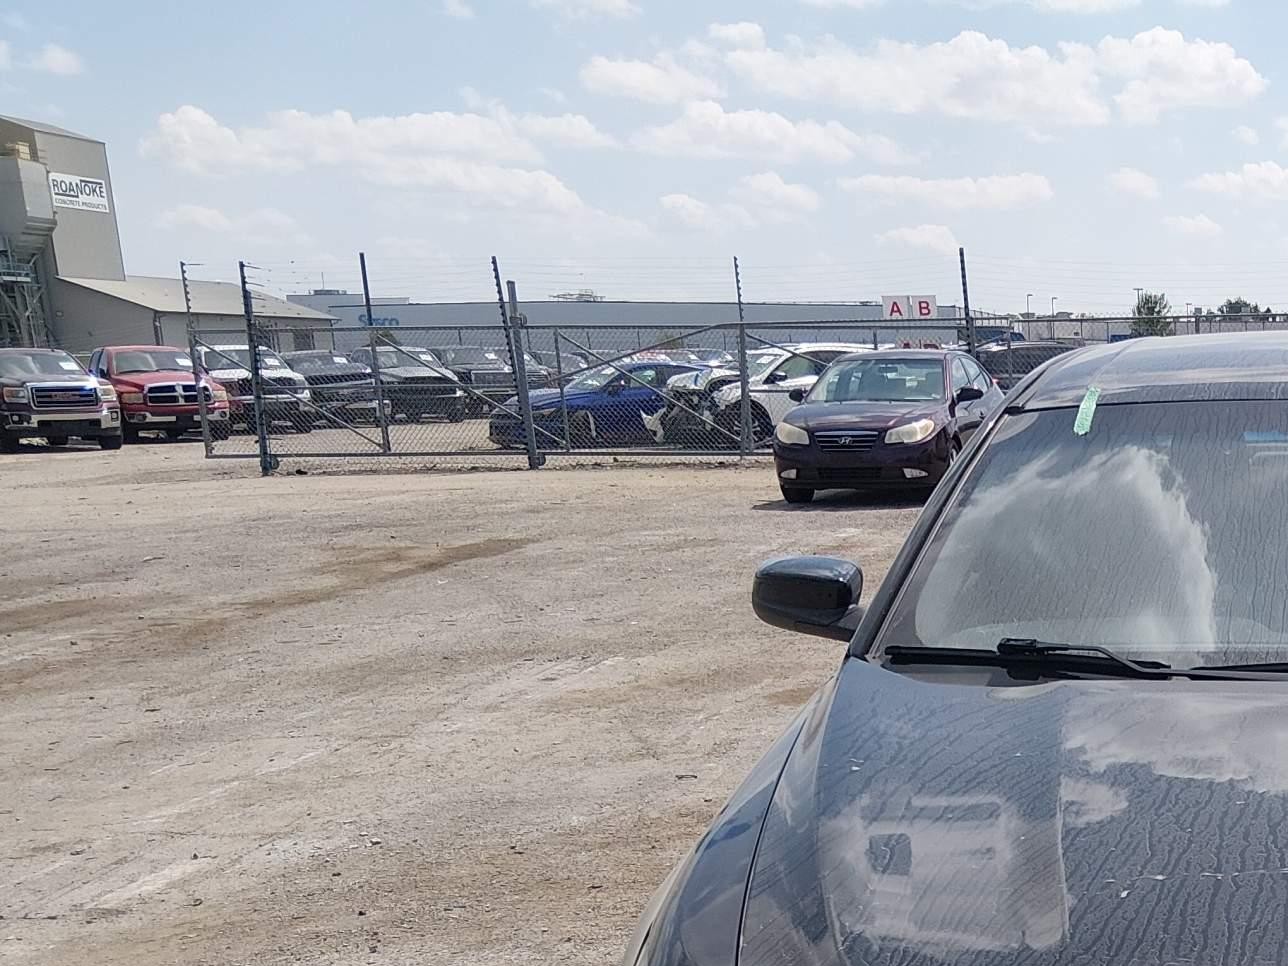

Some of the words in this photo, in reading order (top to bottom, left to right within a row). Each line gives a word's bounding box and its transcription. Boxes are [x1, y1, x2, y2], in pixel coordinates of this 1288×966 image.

[51, 178, 105, 198] ROANOKE
[889, 301, 904, 317] A
[918, 300, 931, 317] B
